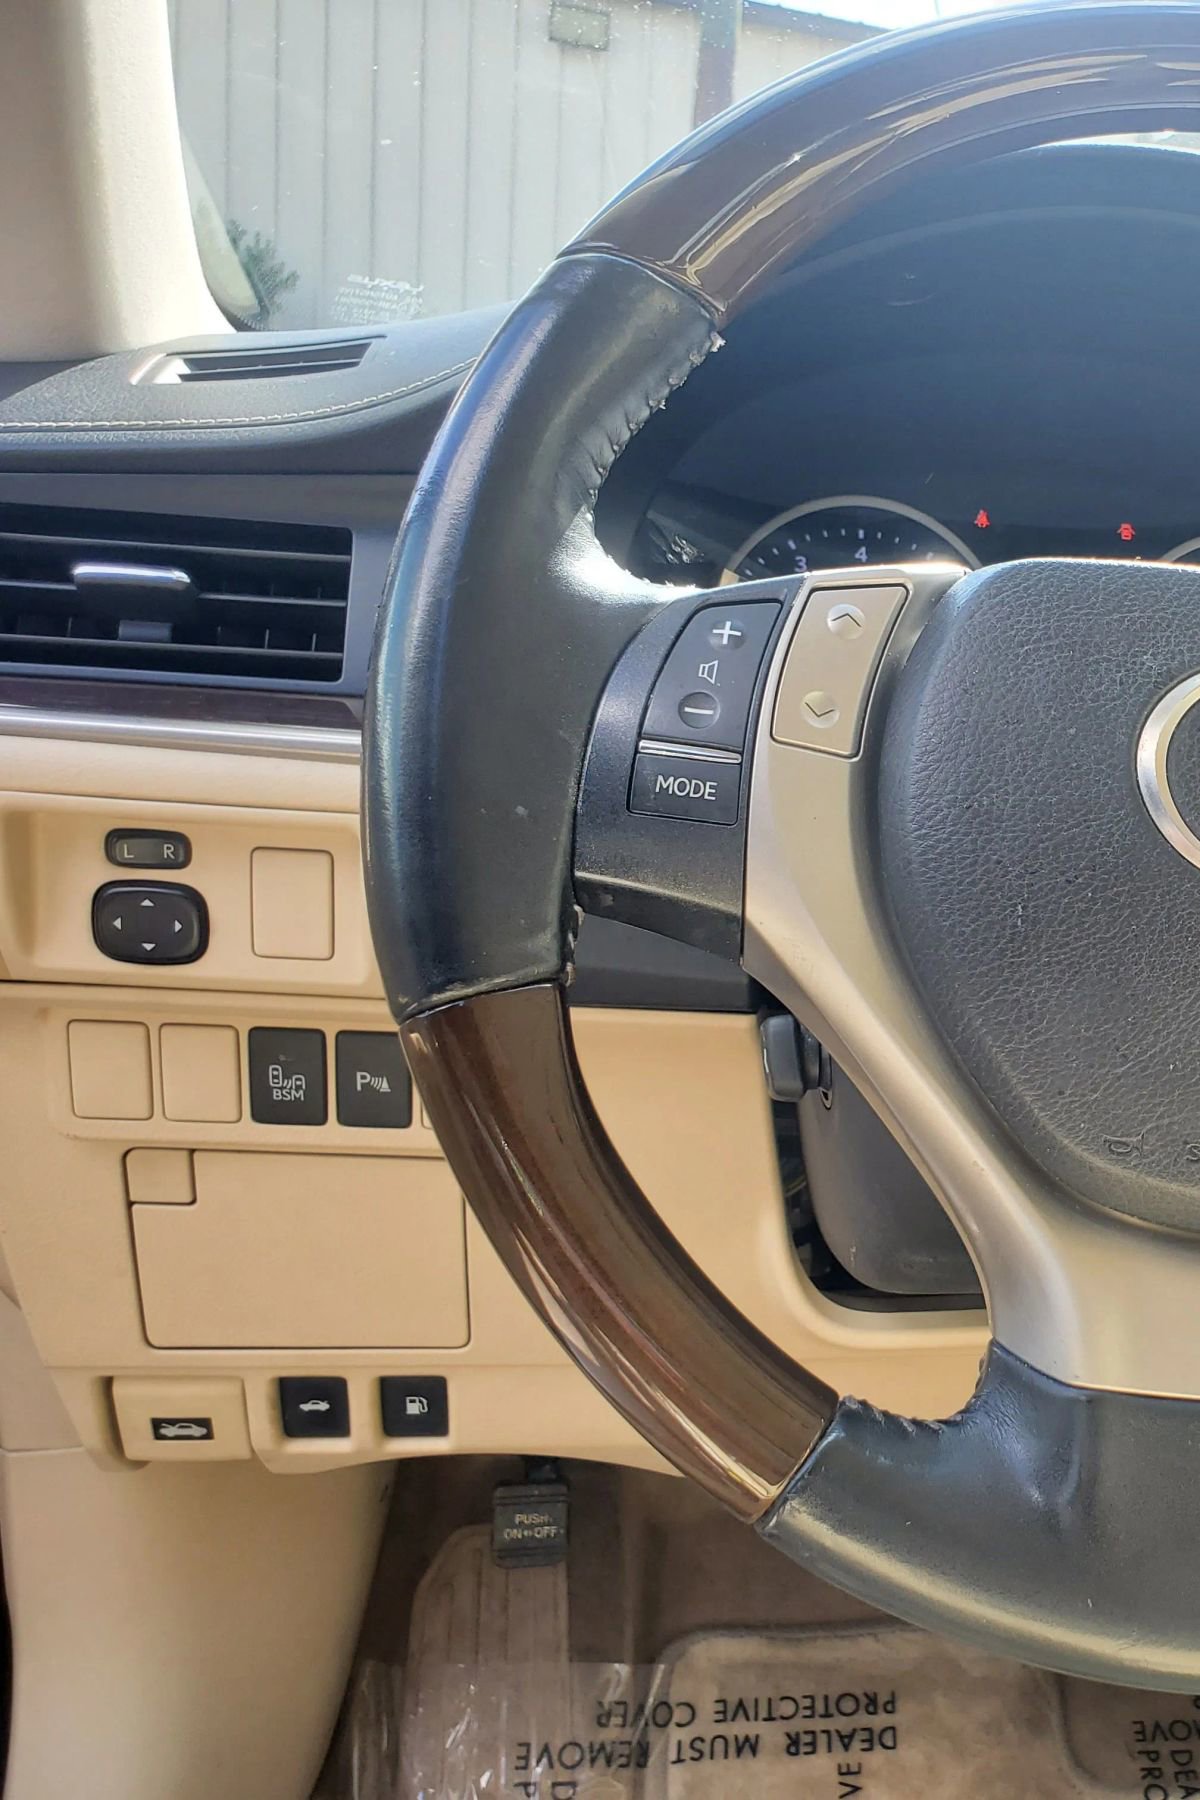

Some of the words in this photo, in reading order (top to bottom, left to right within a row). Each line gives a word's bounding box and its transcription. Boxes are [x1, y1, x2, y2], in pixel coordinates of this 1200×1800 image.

[794, 555, 808, 573] 3
[854, 546, 868, 563] 4
[655, 774, 718, 801] MODE
[123, 844, 135, 859] L
[163, 844, 175, 859] R
[272, 1089, 305, 1101] BSM
[515, 1513, 552, 1525] PUSH
[596, 1699, 697, 1729] COVER
[714, 1690, 897, 1723] PROTECTIVE
[515, 1738, 651, 1771] REMOVE
[671, 1733, 760, 1765] MUST
[785, 1725, 898, 1757] DEALER
